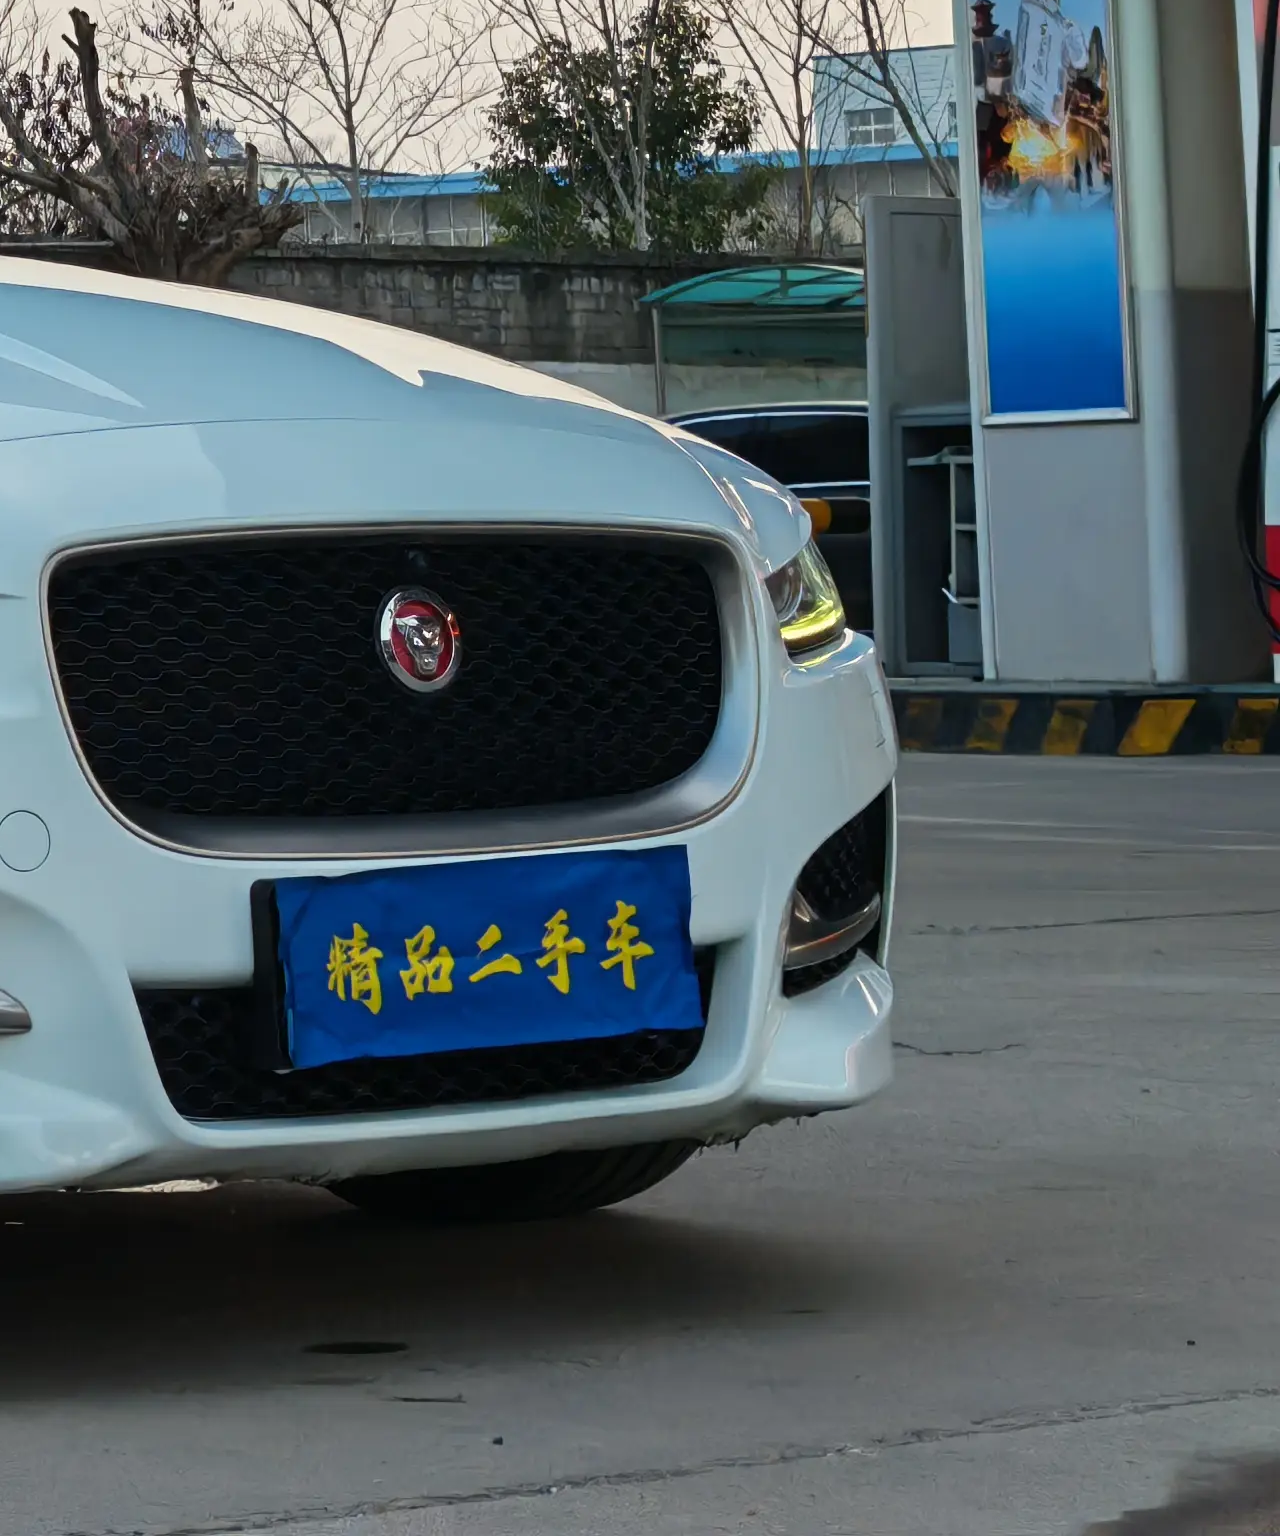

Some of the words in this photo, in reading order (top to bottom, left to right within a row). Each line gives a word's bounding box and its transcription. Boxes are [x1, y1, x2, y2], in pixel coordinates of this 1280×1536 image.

[326, 899, 654, 1015] 精品二手车
